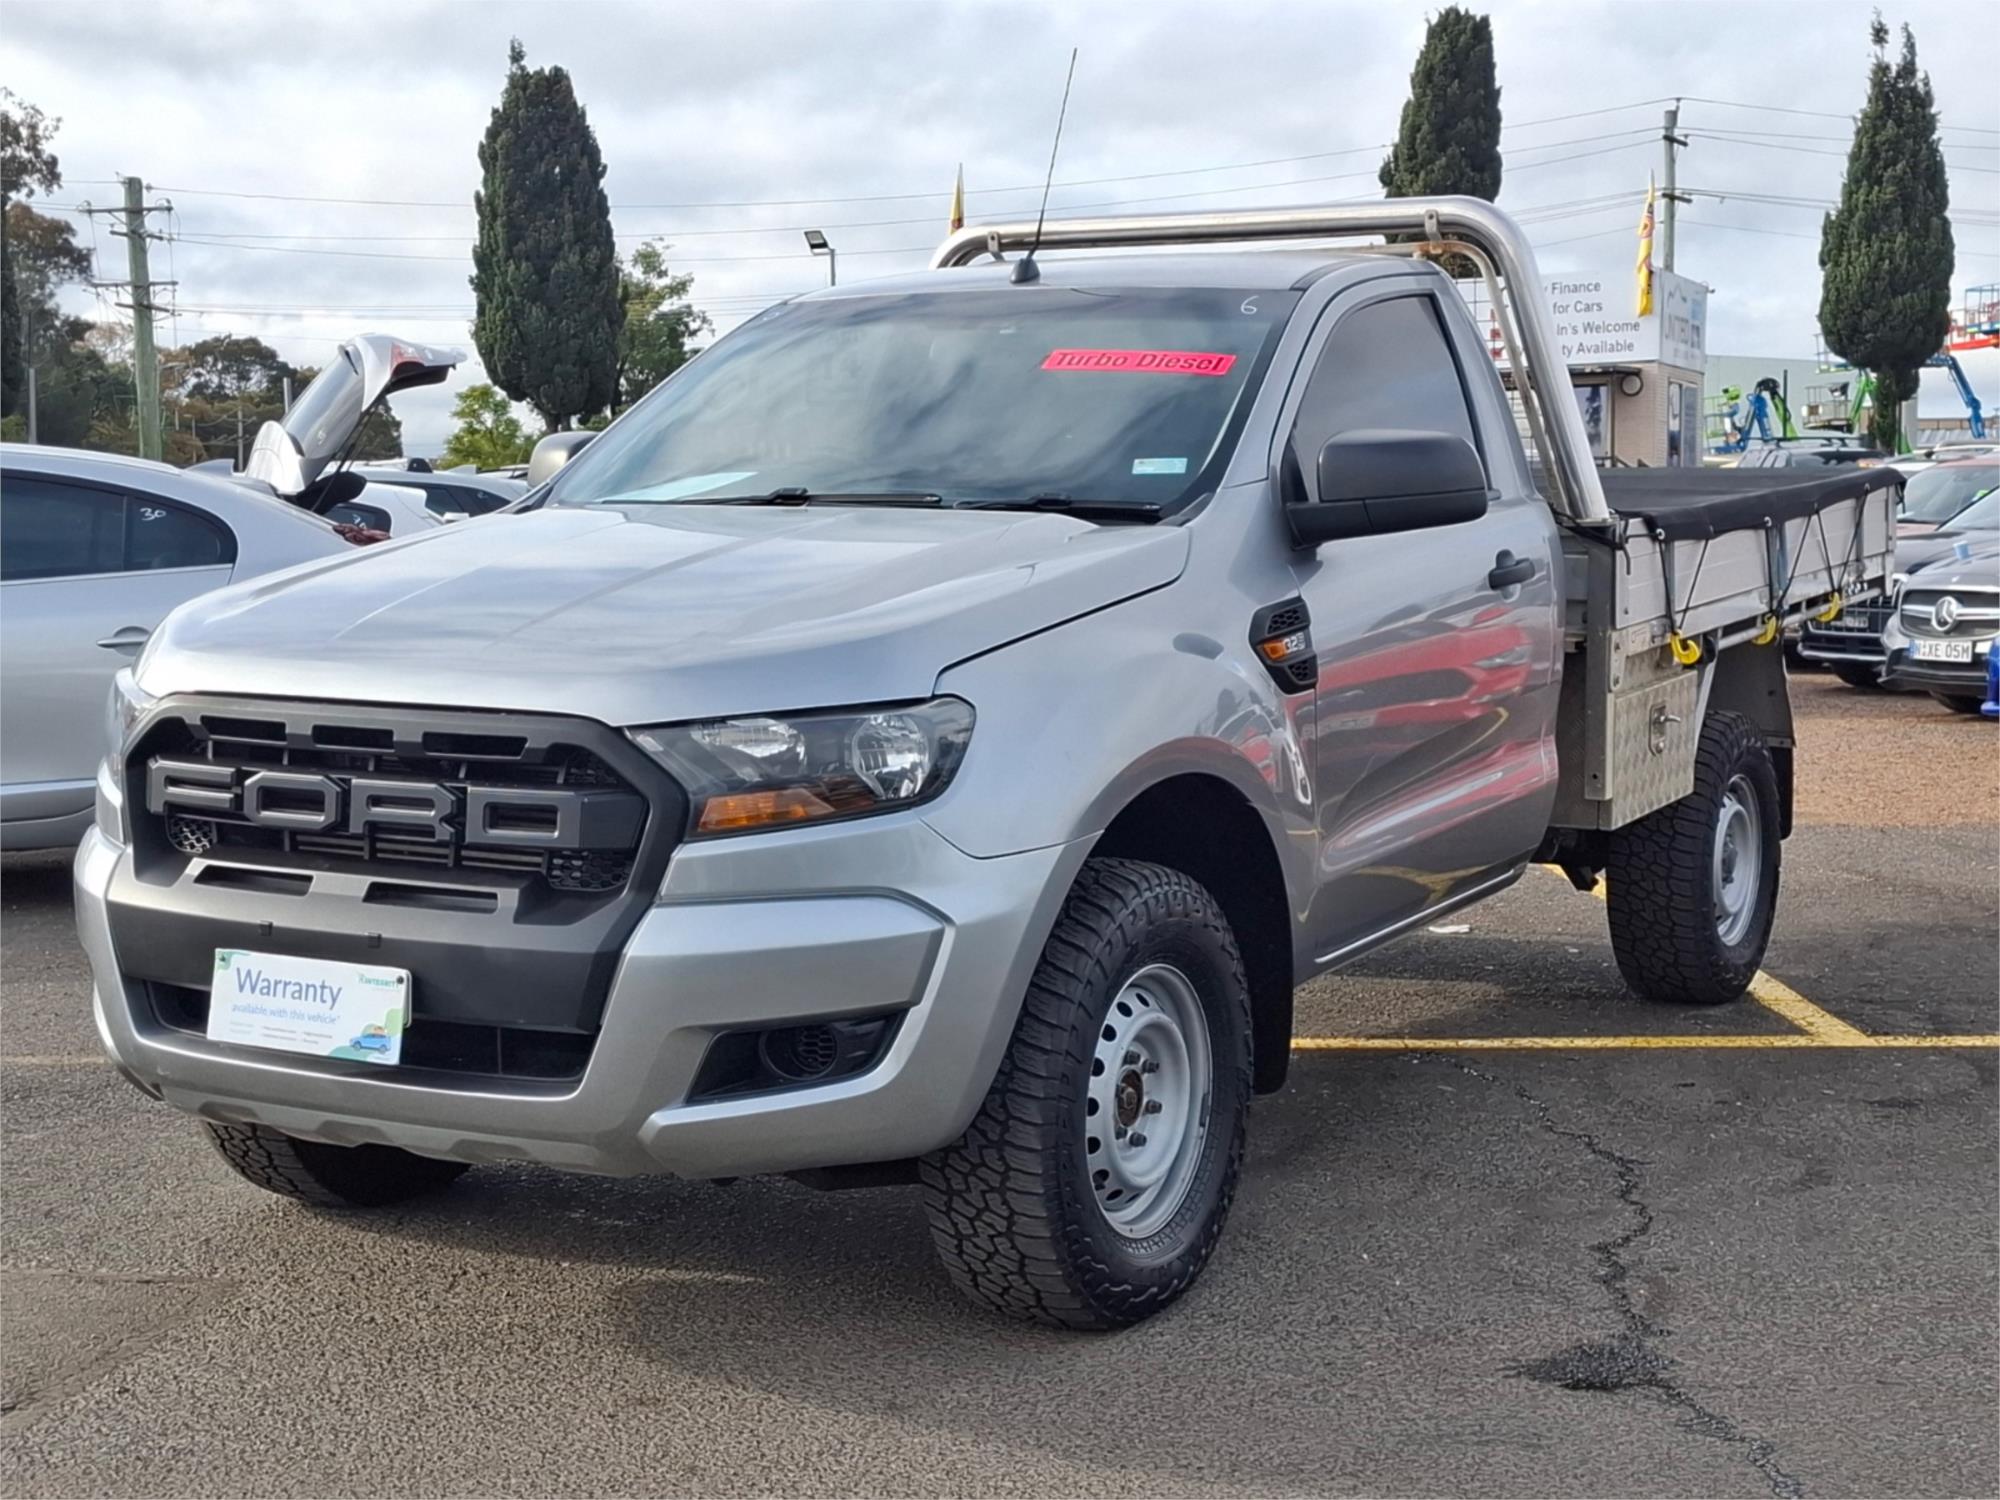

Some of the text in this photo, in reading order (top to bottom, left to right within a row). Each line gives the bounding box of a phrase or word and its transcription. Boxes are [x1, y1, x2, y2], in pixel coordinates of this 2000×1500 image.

[1551, 282, 1601, 295] Finance
[1240, 295, 1259, 315] 6
[1552, 300, 1603, 315] for Cars
[1582, 320, 1640, 334] Welcome
[1576, 338, 1634, 354] Available
[1056, 352, 1225, 371] Turbo Diesel
[139, 507, 167, 521] 30
[146, 755, 581, 848] FORD
[236, 967, 343, 1010] Warranty
[232, 1003, 268, 1015] available
[269, 1007, 288, 1018] with
[289, 1009, 306, 1020] this
